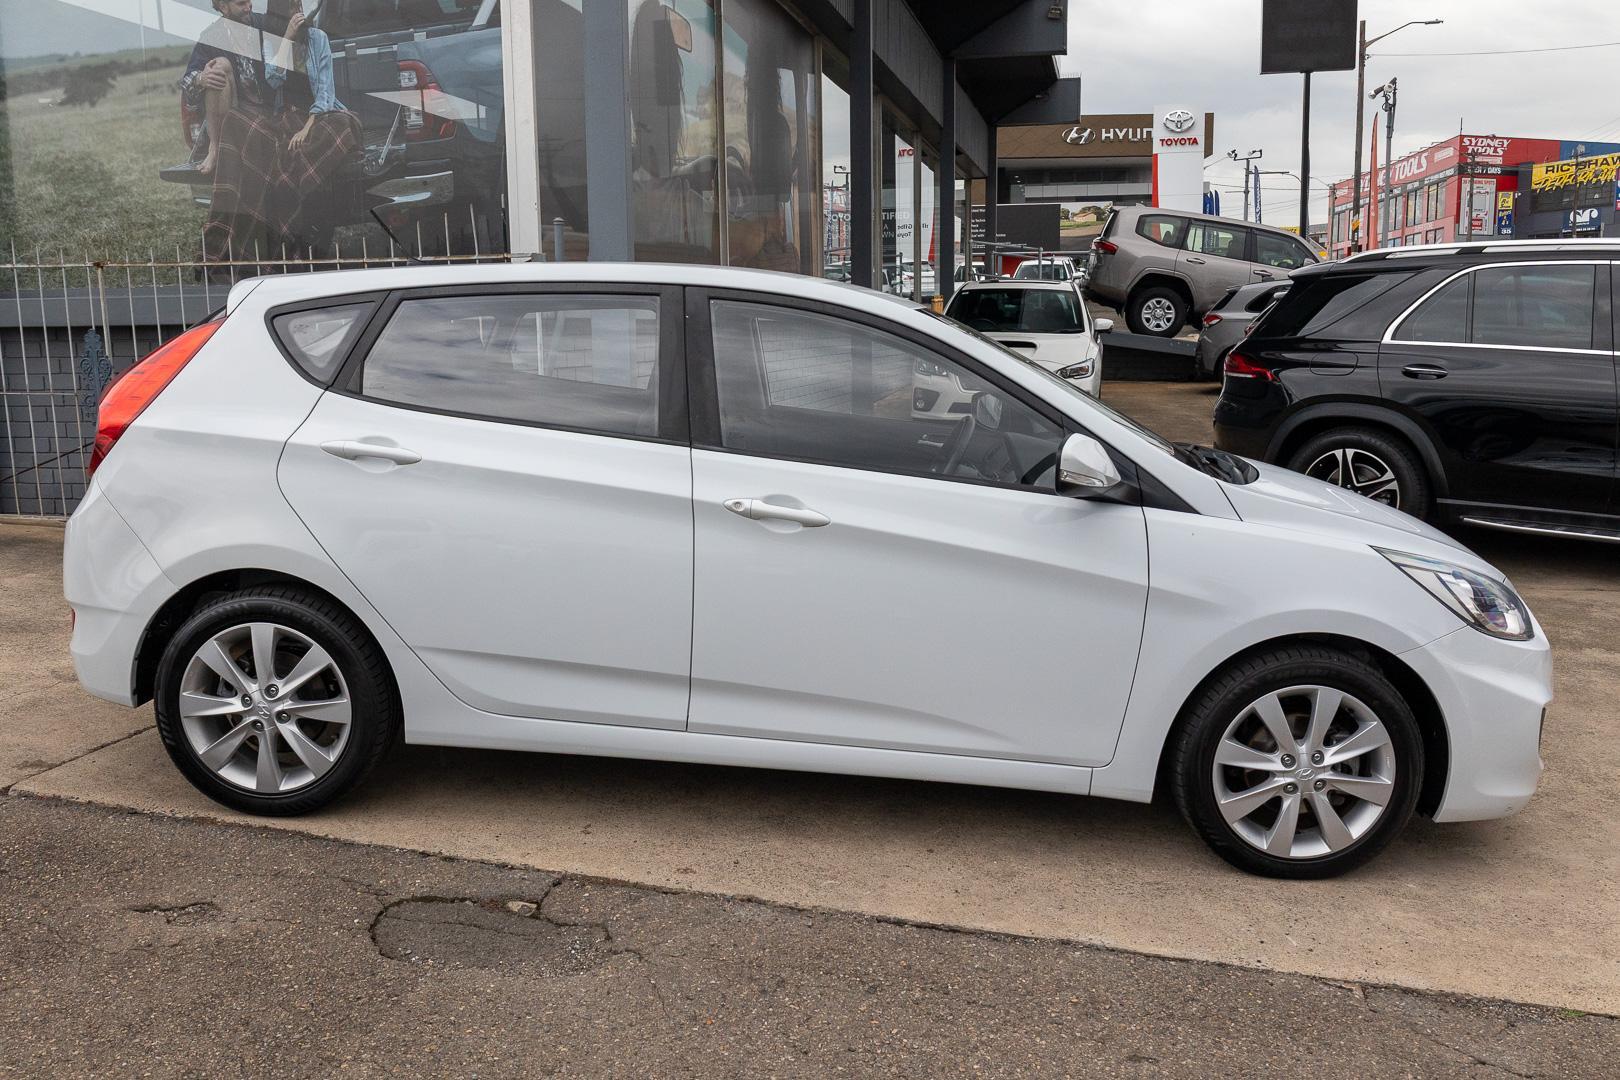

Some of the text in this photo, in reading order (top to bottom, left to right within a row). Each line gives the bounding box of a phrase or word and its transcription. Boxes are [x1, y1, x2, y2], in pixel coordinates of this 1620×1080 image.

[1160, 137, 1198, 146] TOYOTA
[1462, 137, 1511, 147] SYDNEY
[1467, 146, 1505, 156] TOOLS
[1394, 152, 1428, 181] TOOLS
